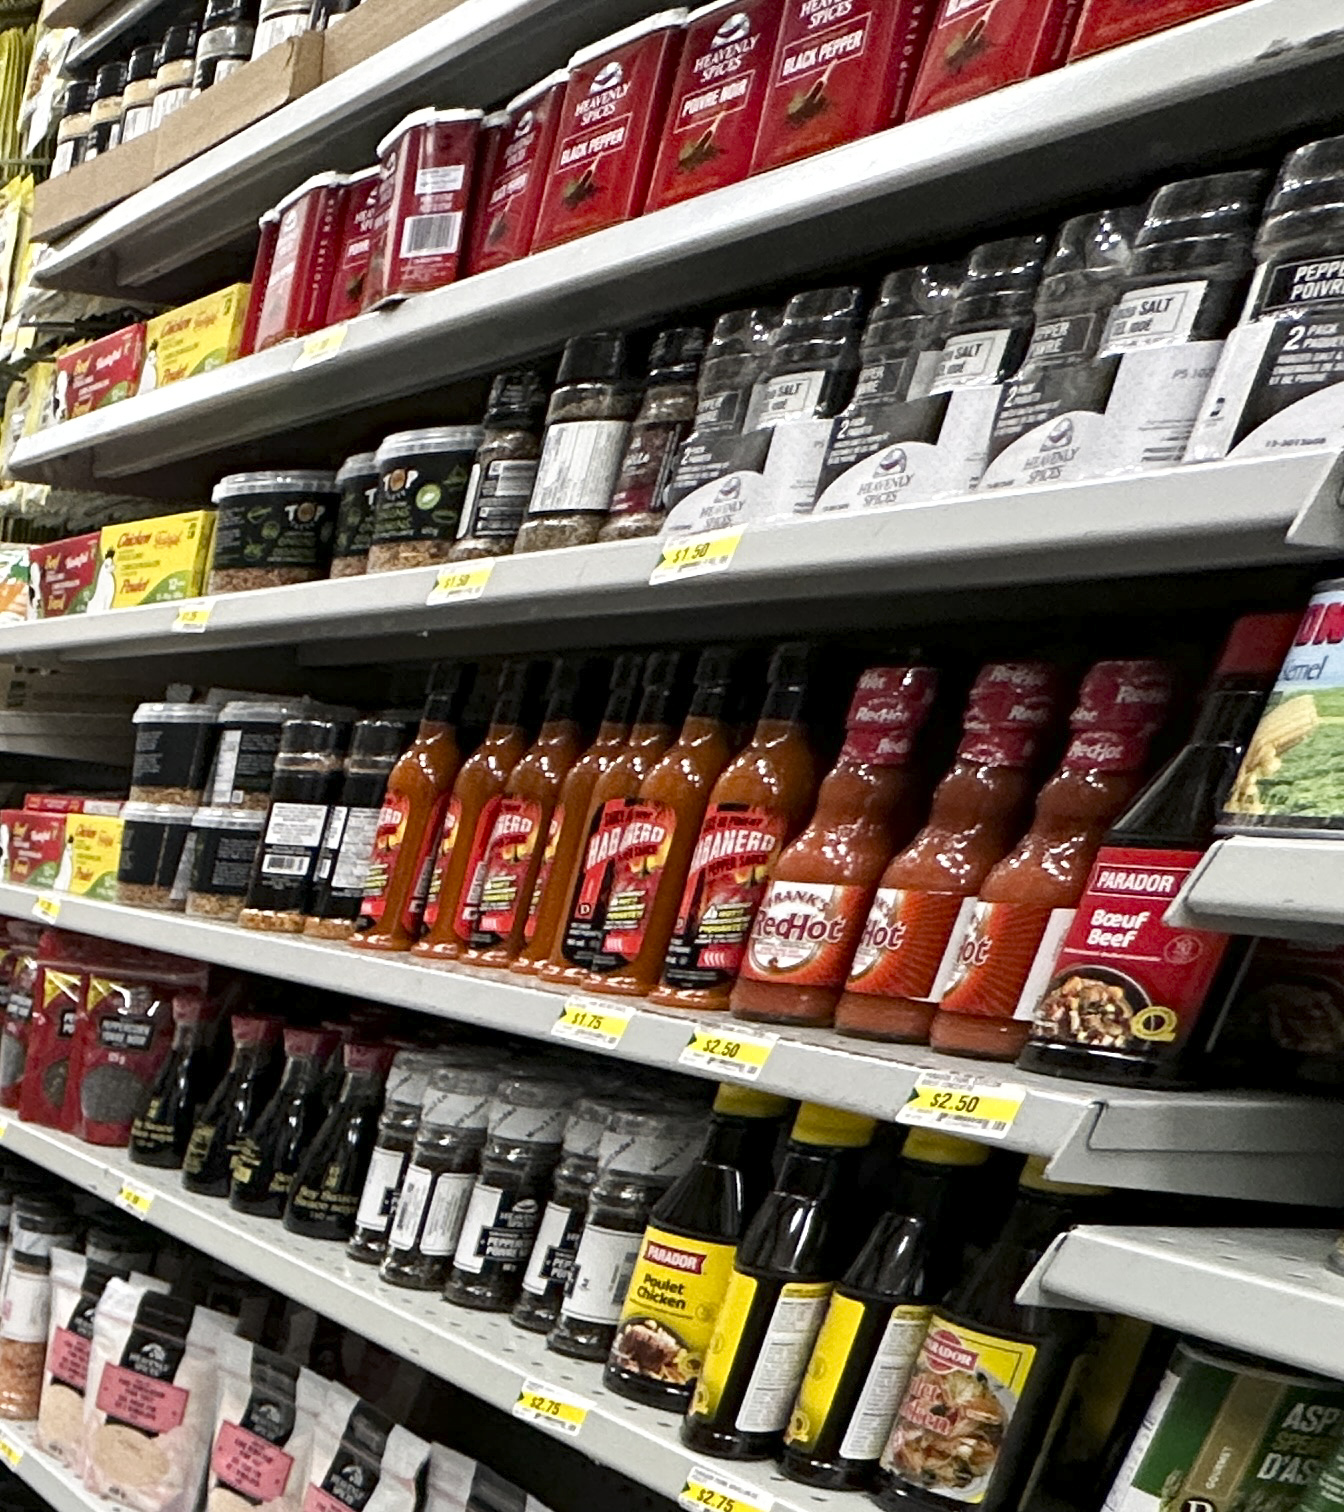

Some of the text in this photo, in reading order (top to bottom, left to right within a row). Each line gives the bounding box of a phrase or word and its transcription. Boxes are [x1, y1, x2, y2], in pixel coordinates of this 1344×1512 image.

[693, 33, 761, 73] HEAVENLY
[782, 29, 864, 76] BLACK PEPPER
[700, 55, 742, 83] SPICES
[574, 81, 631, 117] HEAVENLY
[580, 103, 616, 126] SPICES
[561, 145, 588, 165] BLACK
[588, 127, 625, 153] PEPPER
[1139, 297, 1174, 315] SALT
[1284, 326, 1305, 350] 2
[954, 344, 982, 359] SALT
[1004, 387, 1017, 407] 2
[837, 419, 850, 439] 2
[1023, 447, 1080, 470] HEAVENLY
[857, 474, 914, 496] HEAVENLY
[864, 493, 897, 507] SPICES
[672, 542, 710, 564] $1.50
[444, 574, 470, 589] $1.50
[1096, 870, 1175, 895] PARADOR
[1090, 909, 1150, 931] Bœuf
[862, 918, 907, 950] Hot
[1087, 929, 1137, 950] Beef
[571, 1010, 602, 1031] $1.75
[702, 1039, 741, 1058] $2.50
[930, 1092, 980, 1113] $2.50
[646, 1242, 698, 1271] PARADOR
[643, 1273, 685, 1297] Poulet
[637, 1285, 686, 1310] Chicken
[530, 1395, 562, 1416] $2.75
